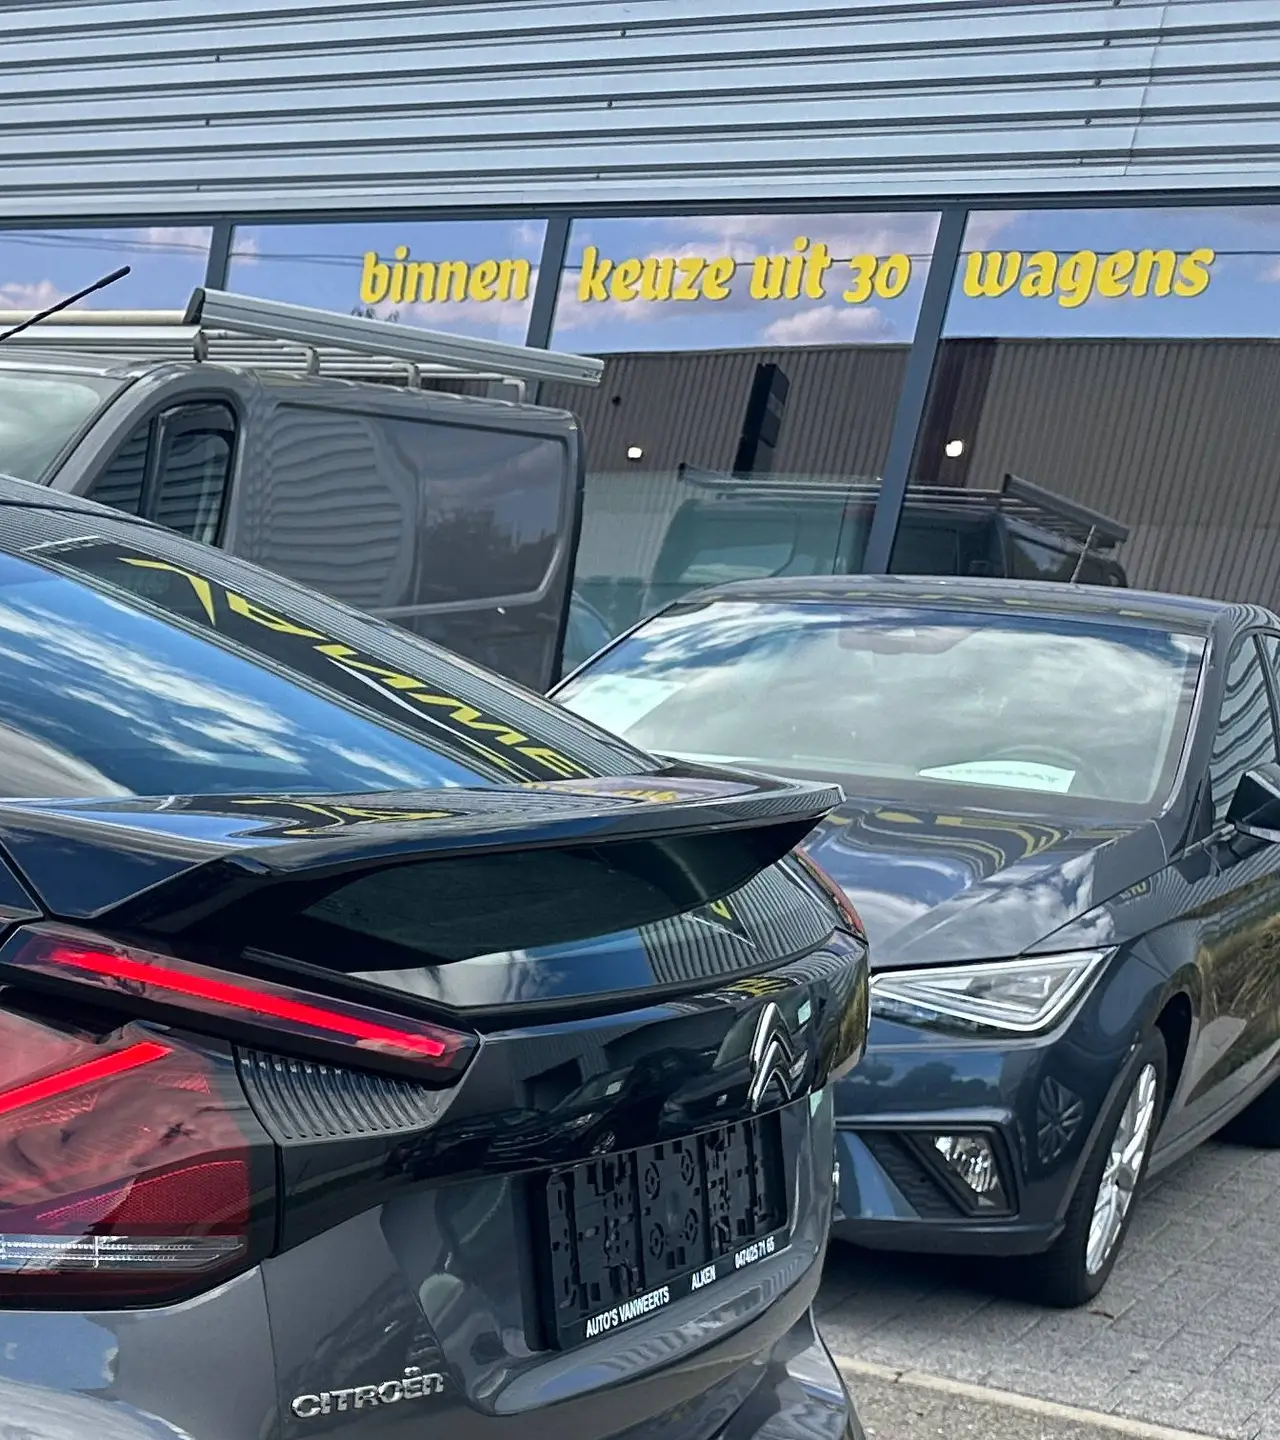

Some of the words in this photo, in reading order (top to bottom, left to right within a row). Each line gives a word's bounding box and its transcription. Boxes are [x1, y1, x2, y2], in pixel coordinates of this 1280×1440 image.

[361, 245, 532, 304] binnen
[577, 246, 736, 302] keuze
[749, 236, 833, 300] uit
[842, 253, 912, 304] 30
[962, 248, 1216, 308] wagens
[586, 1308, 619, 1338] AUTO'S
[619, 1286, 670, 1321] VANWEERTS
[691, 1265, 716, 1291] ALKEN
[292, 1366, 444, 1418] CITROËN
